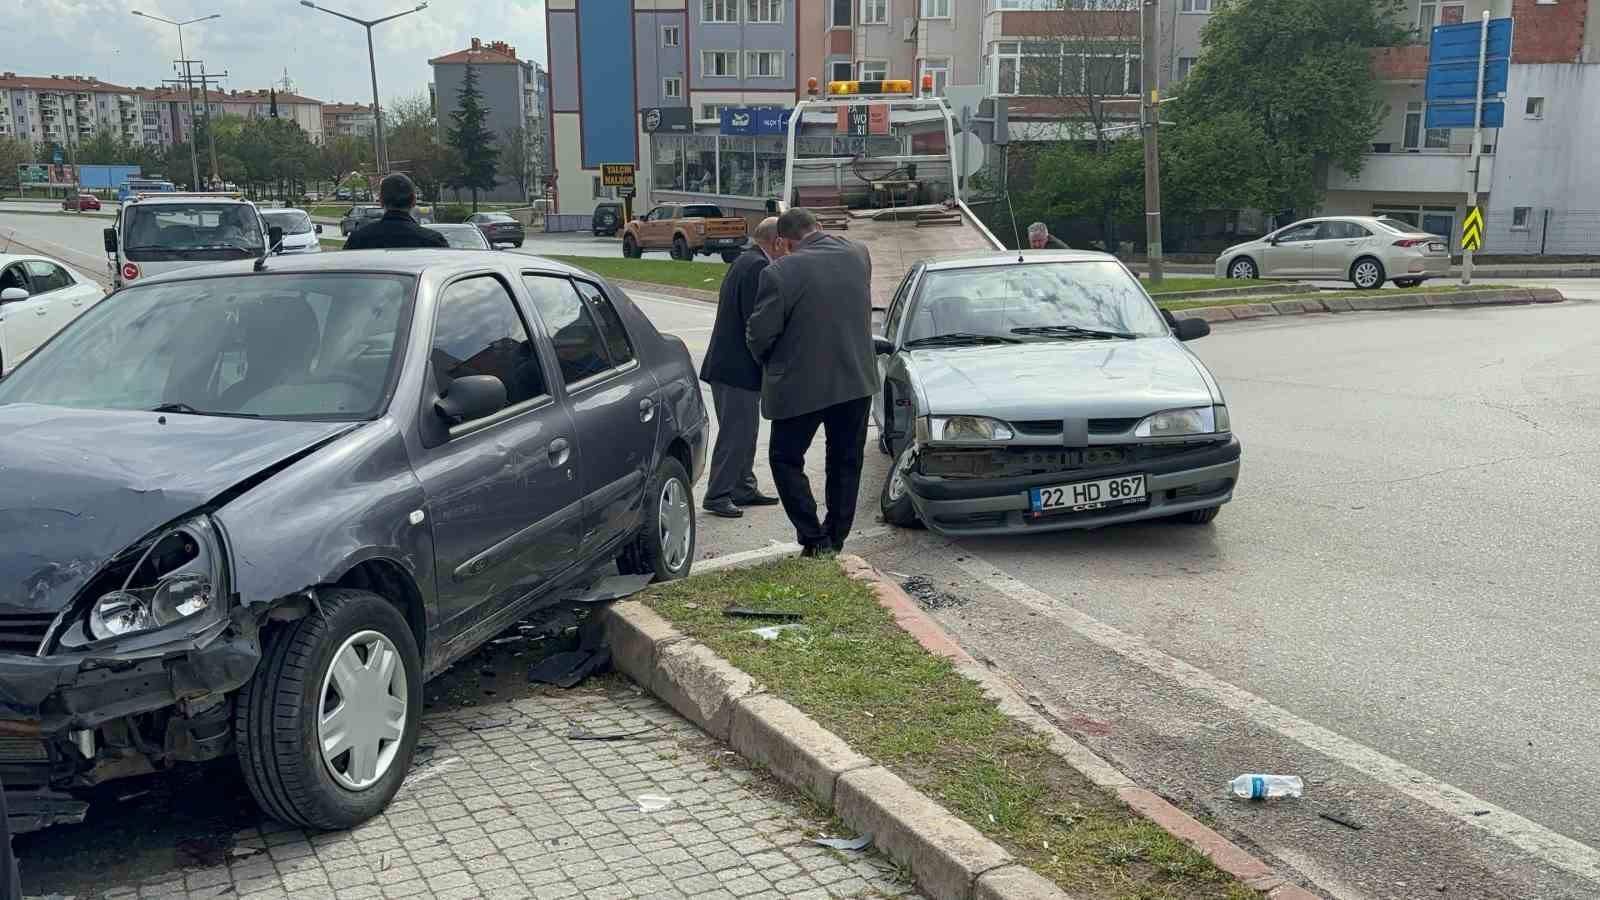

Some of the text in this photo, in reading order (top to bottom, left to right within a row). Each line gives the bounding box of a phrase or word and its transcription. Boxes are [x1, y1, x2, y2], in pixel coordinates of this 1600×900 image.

[853, 112, 867, 124] WO
[857, 125, 866, 135] RI
[1041, 477, 1142, 508] 22 HD 867
